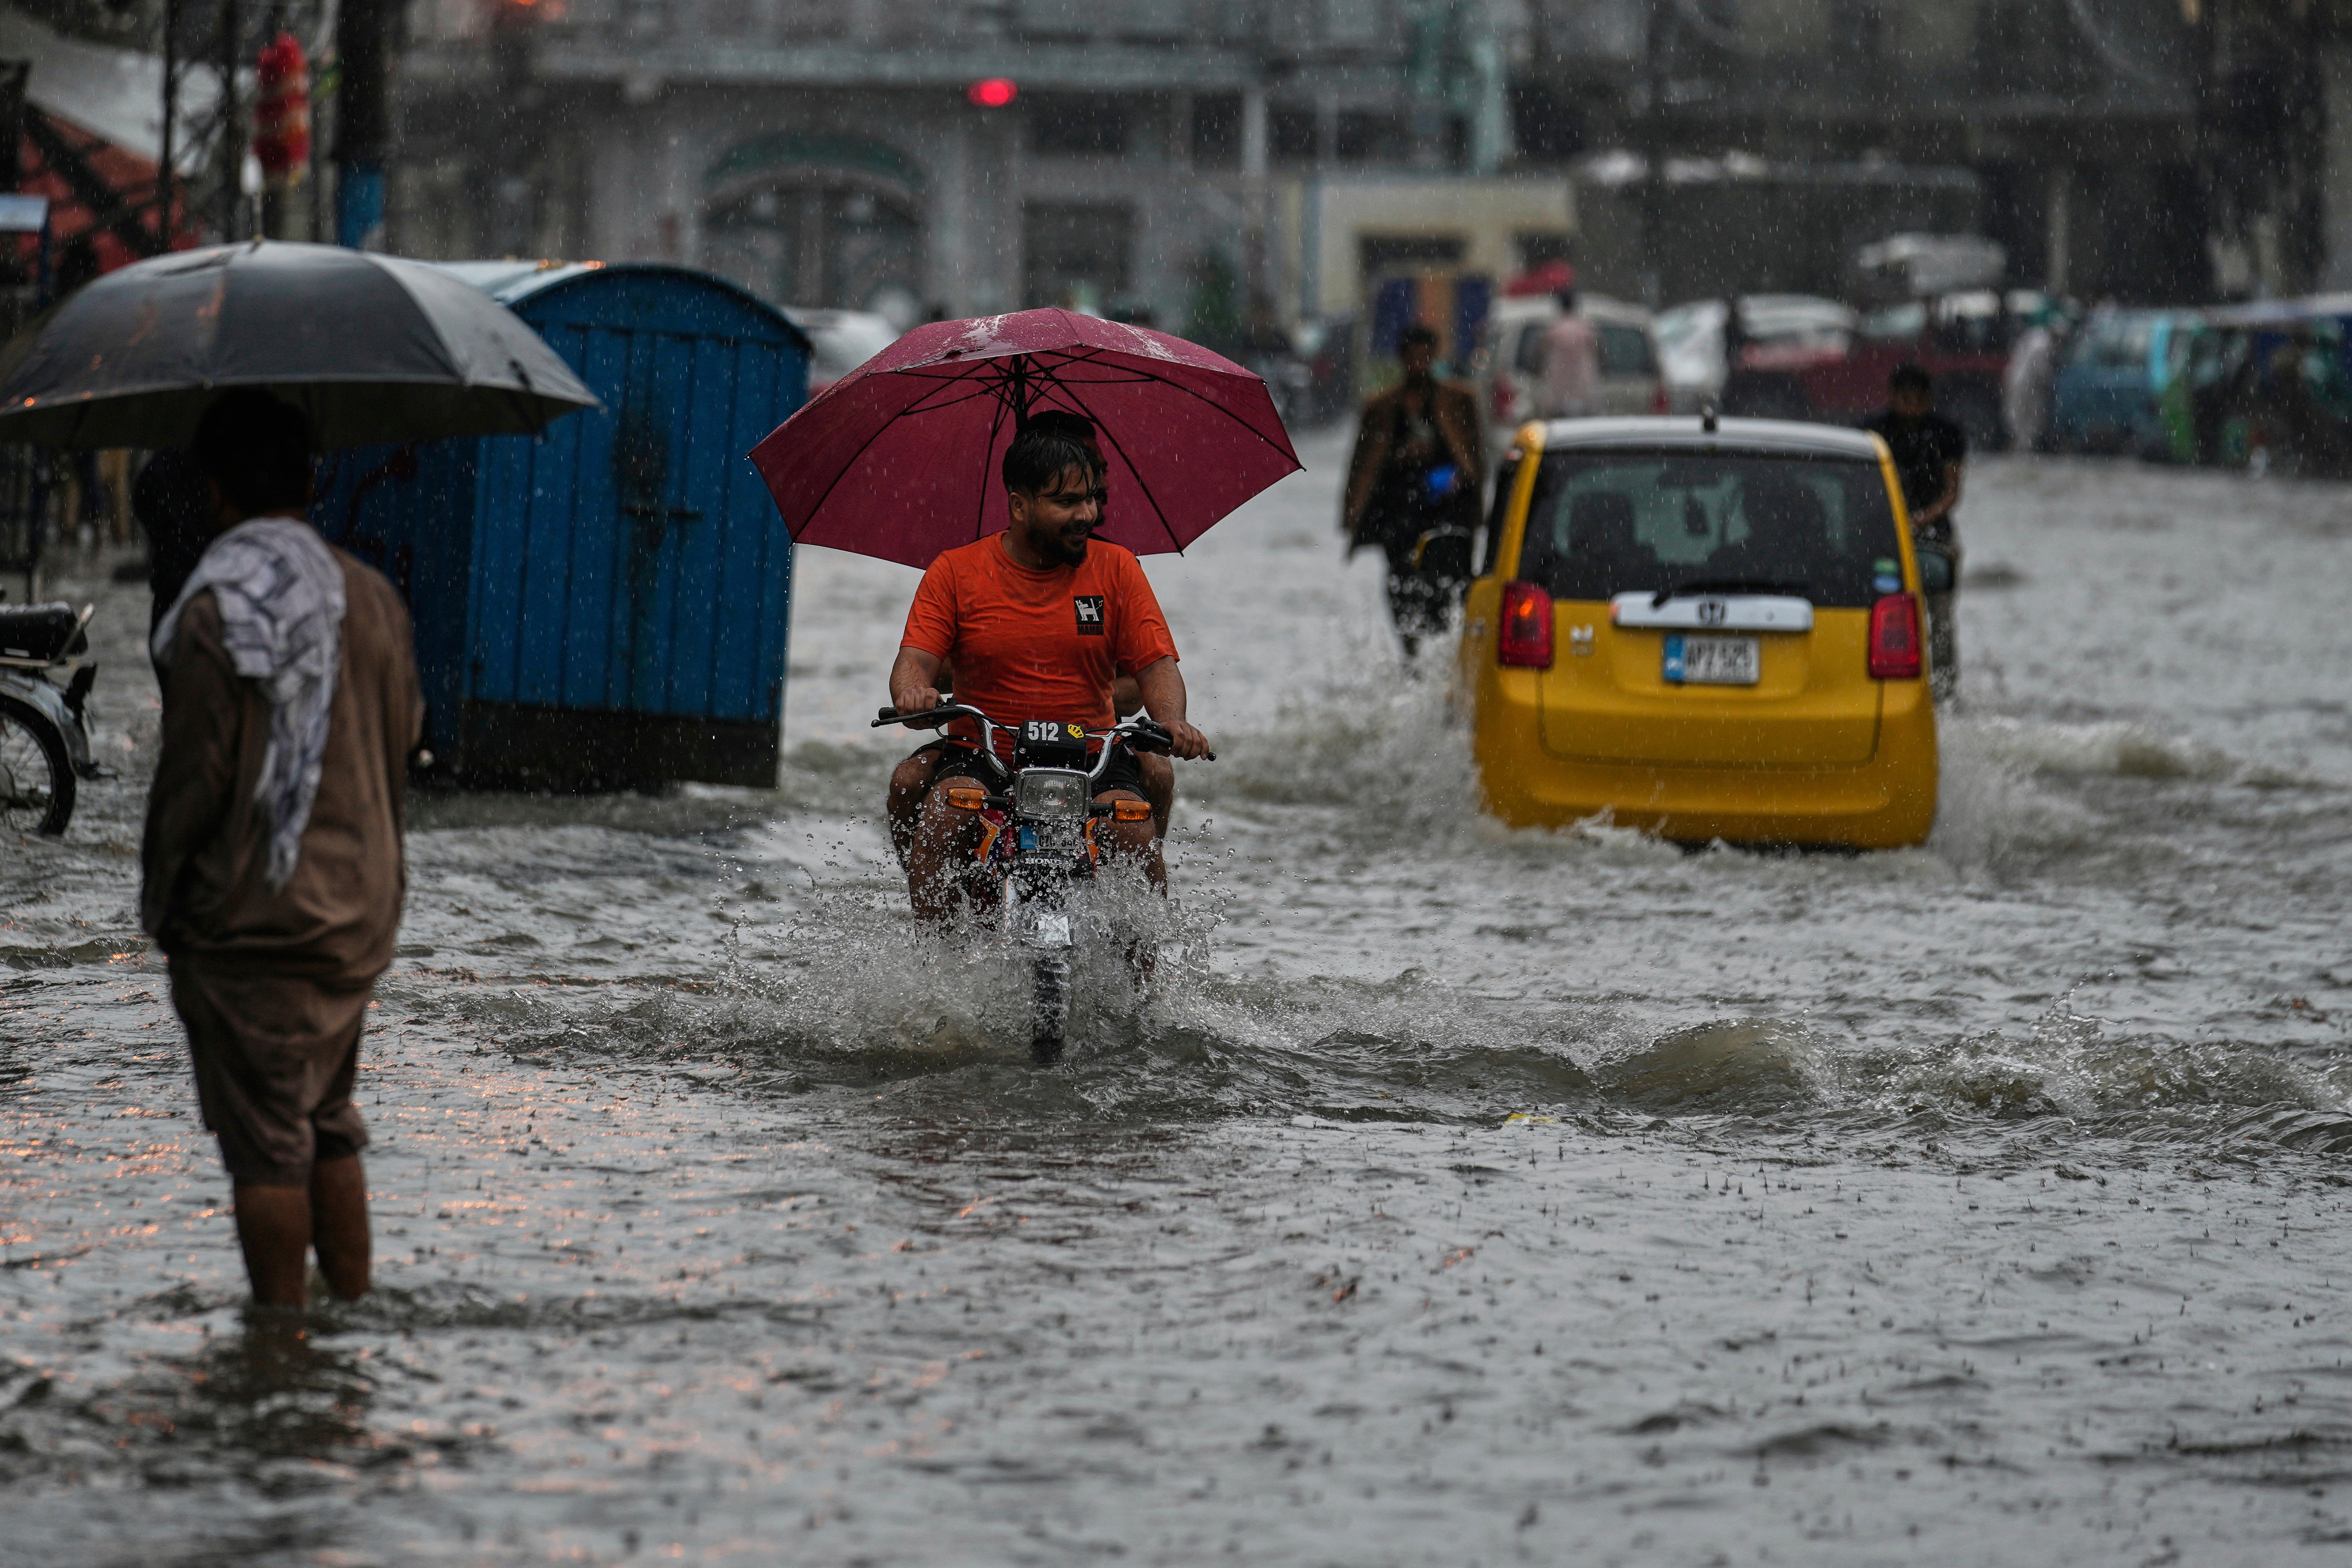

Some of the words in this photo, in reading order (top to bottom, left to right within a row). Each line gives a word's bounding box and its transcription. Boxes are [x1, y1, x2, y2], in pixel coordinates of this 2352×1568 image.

[1078, 625, 1104, 636] MAMBO
[1028, 722, 1059, 741] 512
[1025, 858, 1068, 866] HOND
